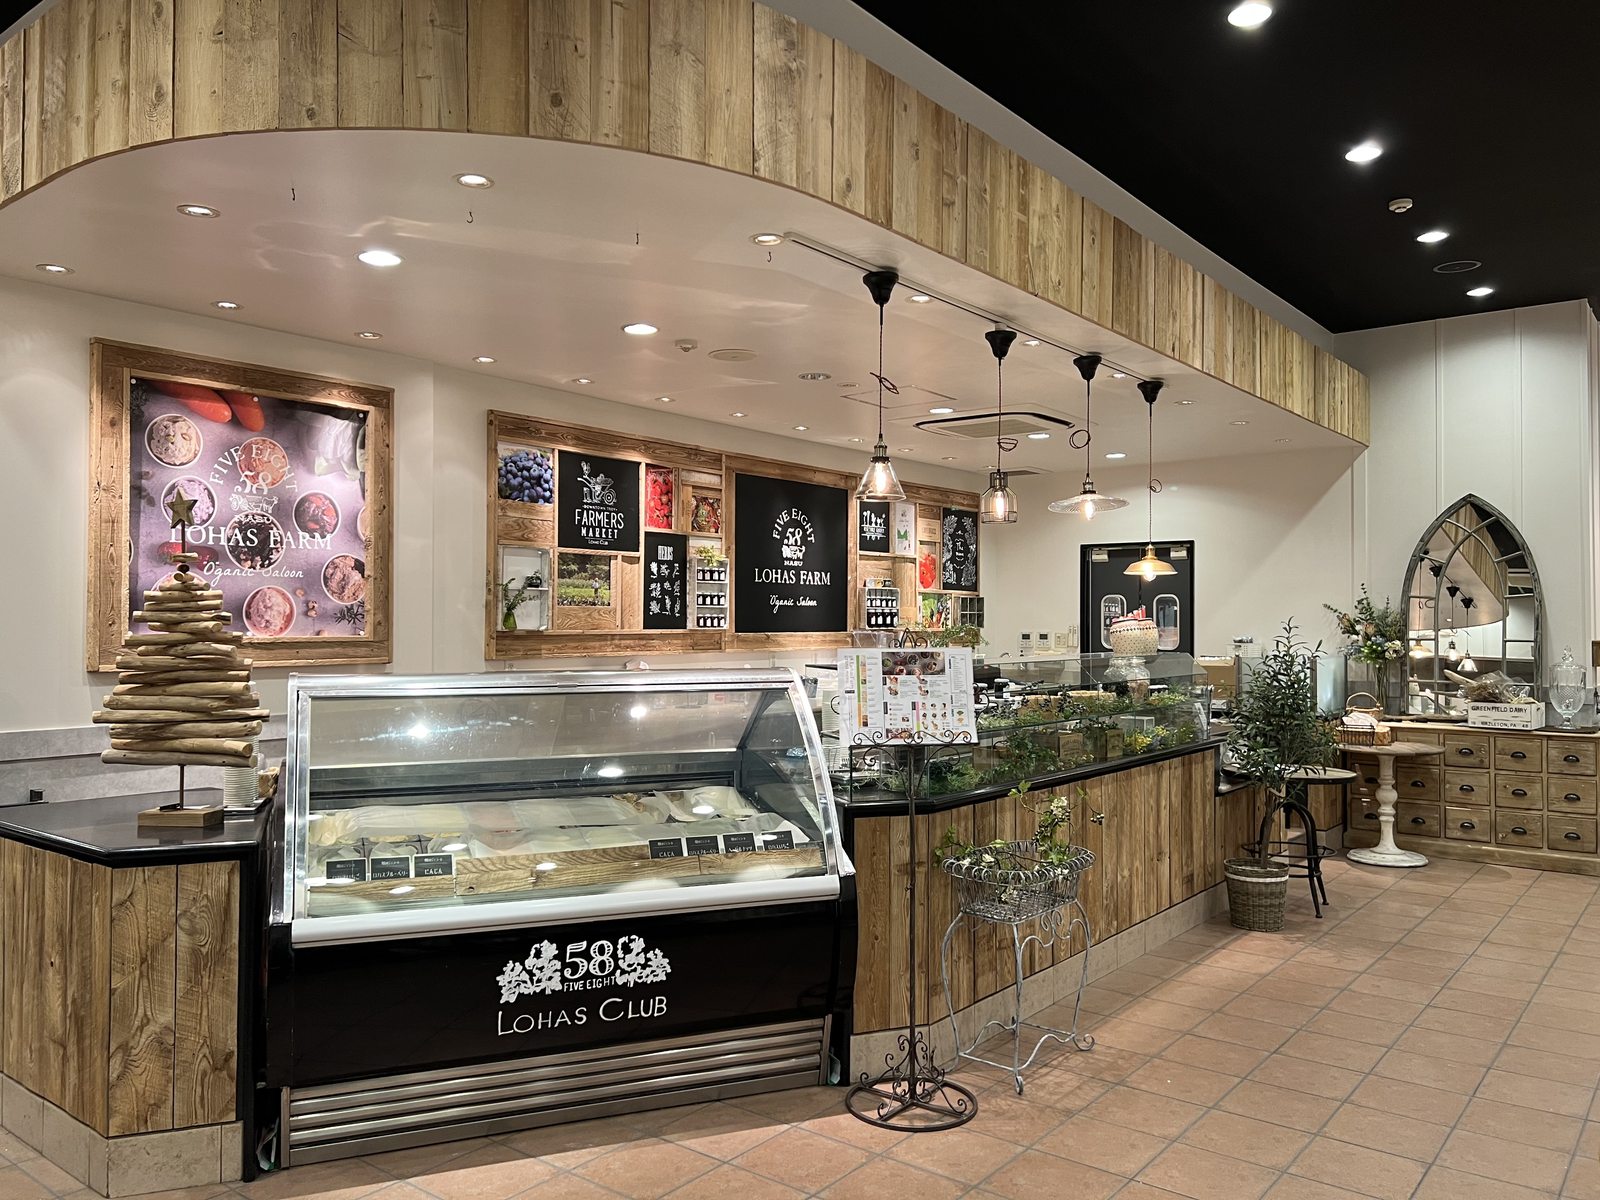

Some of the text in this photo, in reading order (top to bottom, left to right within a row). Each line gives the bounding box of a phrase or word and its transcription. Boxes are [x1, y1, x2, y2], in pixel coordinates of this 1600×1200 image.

[210, 446, 245, 485] FIVE
[234, 470, 272, 494] 58
[575, 508, 624, 529] FARMERS
[772, 508, 815, 543] FIVE EIGHT
[169, 524, 333, 550] LOHAS FARM
[581, 526, 618, 539] MARKET
[783, 527, 803, 545] 58
[754, 568, 831, 585] LOHAS FARM
[1471, 705, 1508, 713] GREENFIELD
[563, 940, 615, 979] 58
[563, 976, 616, 992] FIVE EIGHT
[497, 996, 667, 1036] LOHAS CLUB
